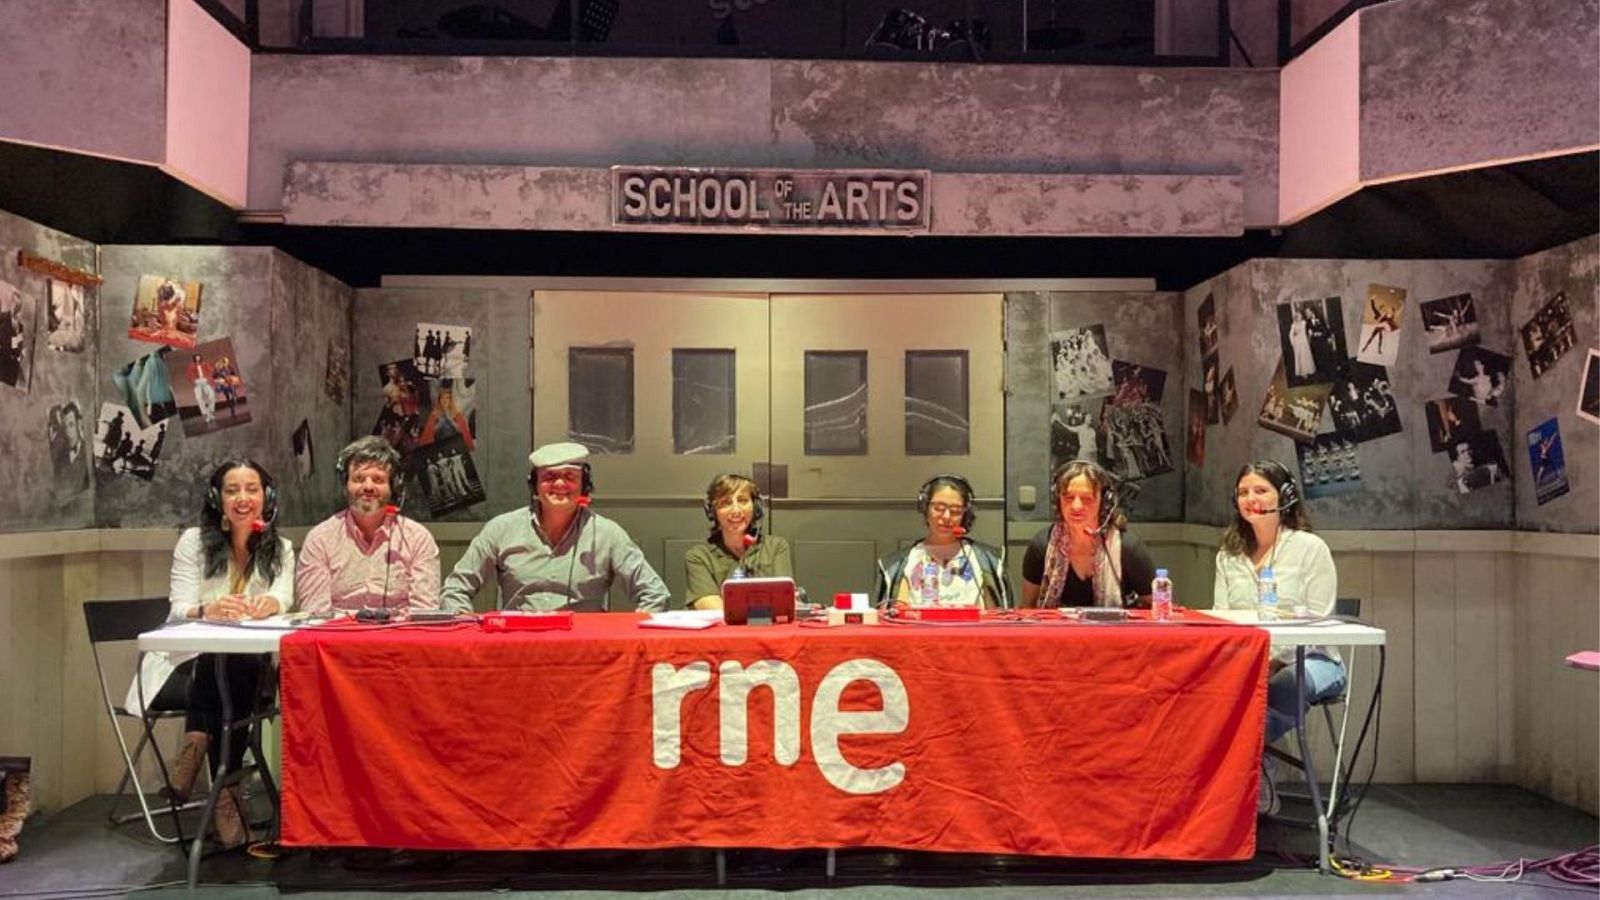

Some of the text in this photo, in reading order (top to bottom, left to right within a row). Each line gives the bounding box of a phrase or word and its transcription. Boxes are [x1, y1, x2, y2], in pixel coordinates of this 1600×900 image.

[624, 177, 920, 221] SCHOOL OF THE ARTS
[652, 658, 910, 794] rne
